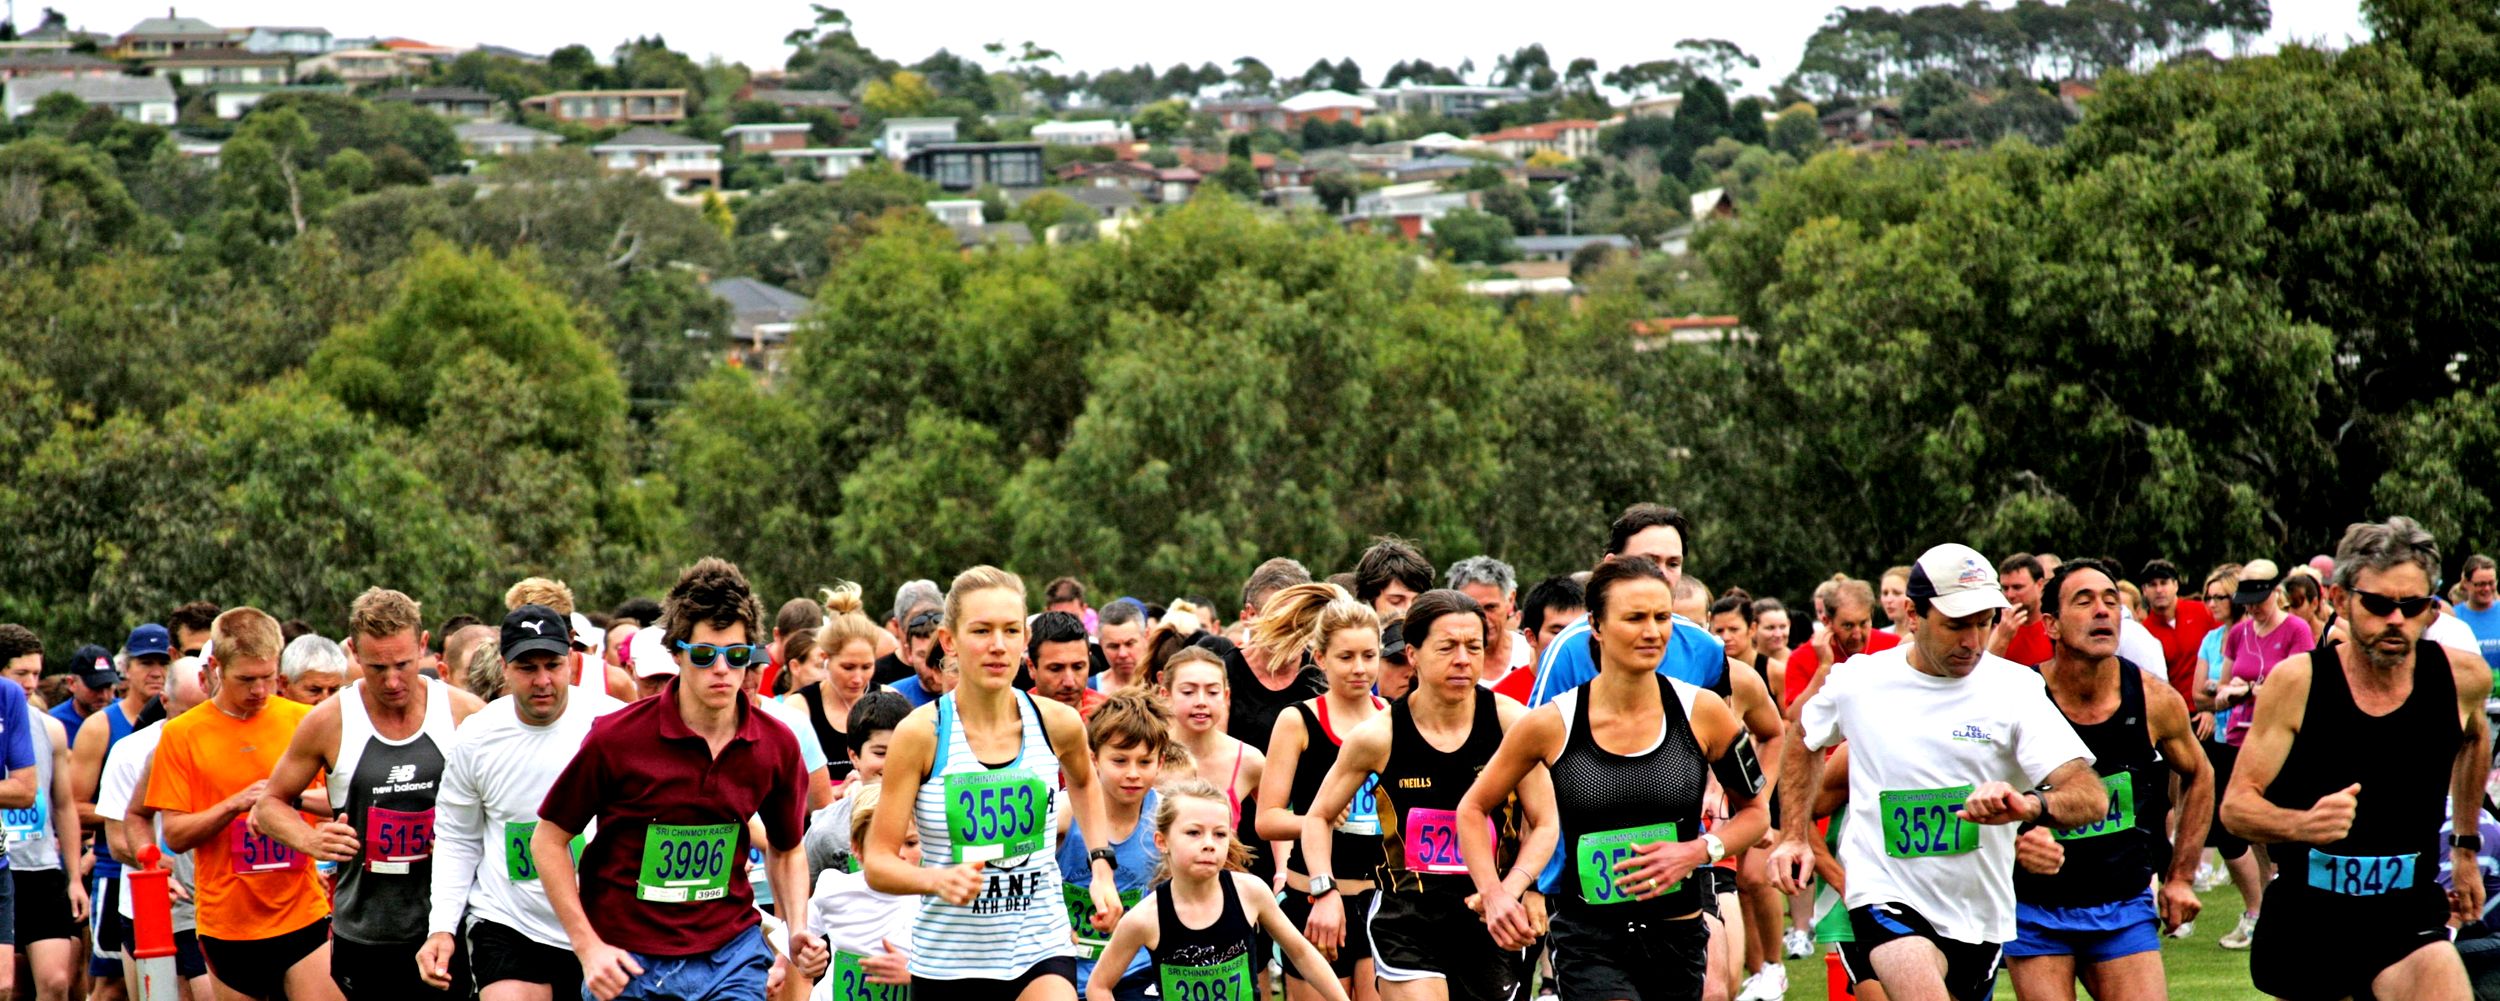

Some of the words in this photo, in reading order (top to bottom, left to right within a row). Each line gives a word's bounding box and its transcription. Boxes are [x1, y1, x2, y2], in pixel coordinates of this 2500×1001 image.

[1952, 730, 1991, 740] CLASSIC
[373, 786, 393, 795] new
[394, 781, 433, 793] balance
[1398, 777, 1432, 789] O'NEILLS
[959, 784, 1035, 843] 3553
[656, 827, 670, 836] SRI
[671, 828, 707, 837] CHINMOY
[709, 825, 734, 836] RACES
[1641, 826, 1670, 840] RACES
[1893, 803, 1964, 855] 3527
[656, 838, 726, 880] 3996
[2324, 857, 2403, 896] 1842
[697, 888, 721, 899] 3996
[1168, 967, 1181, 976] SRI
[1182, 968, 1219, 977] CHINMOY
[1222, 956, 1244, 973] RACES
[1175, 972, 1242, 1001] 3987
